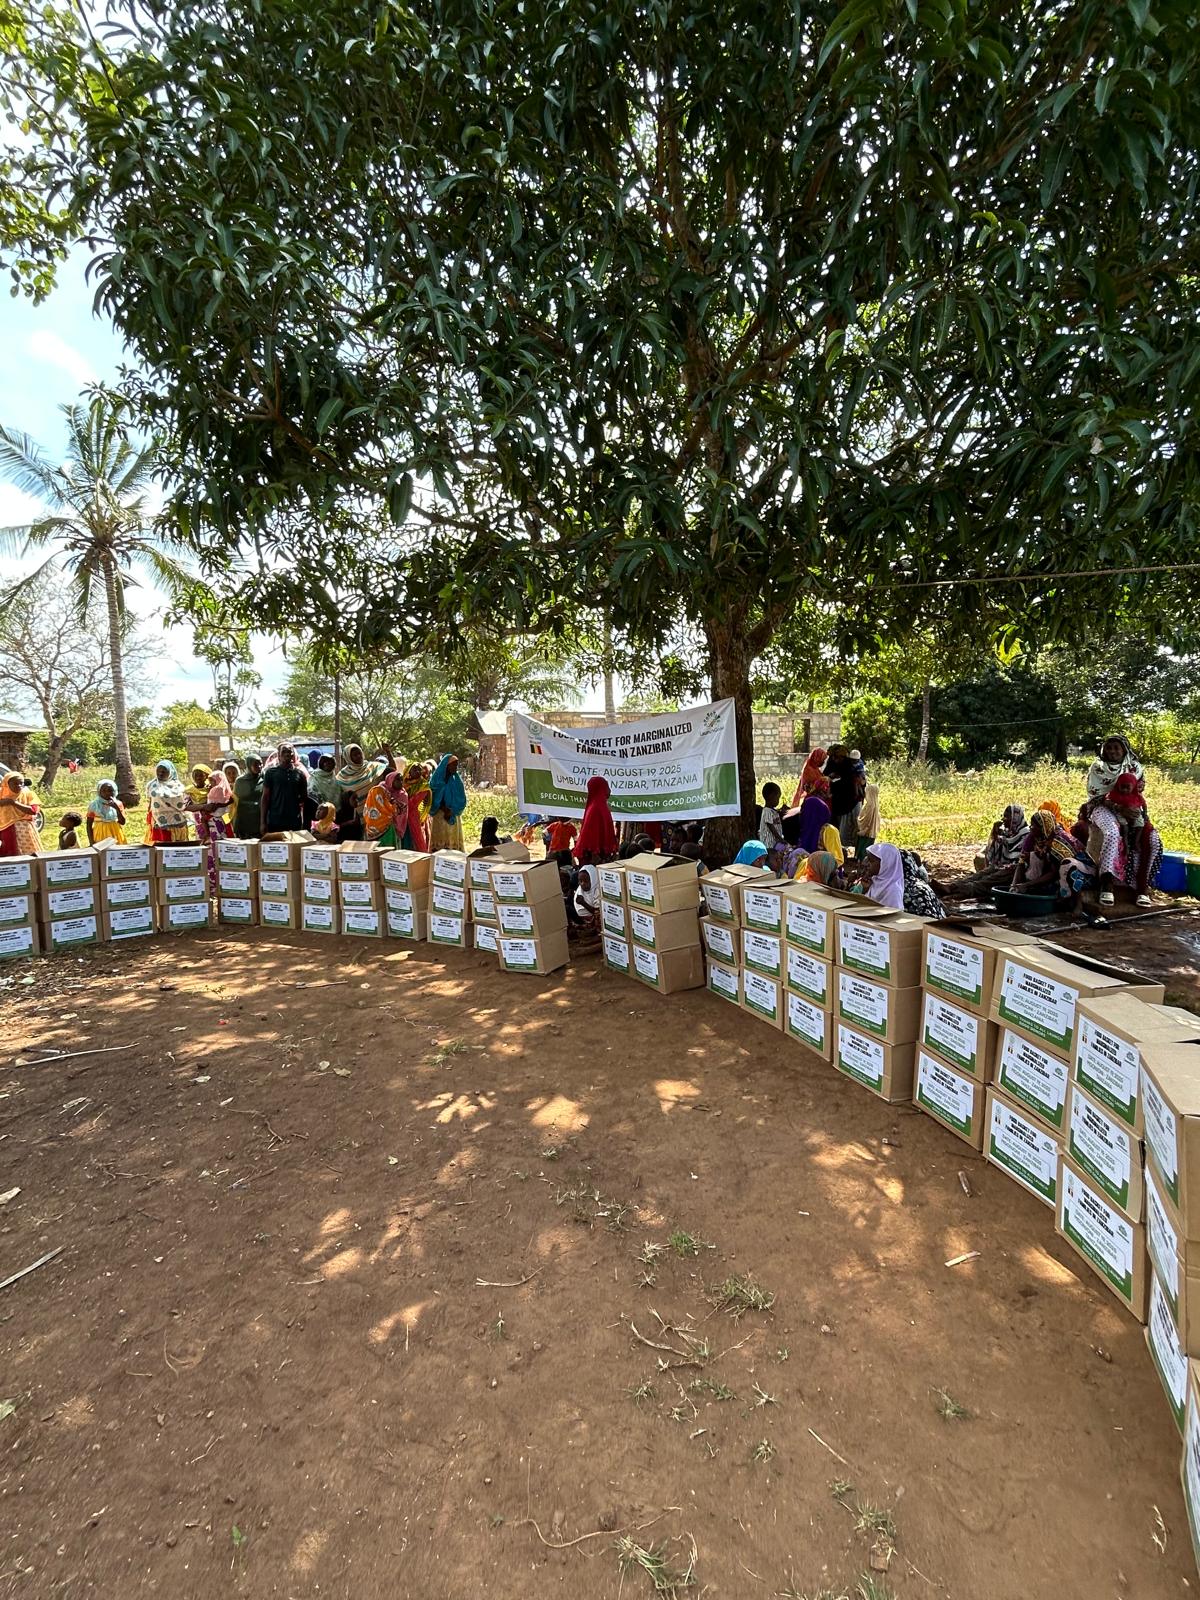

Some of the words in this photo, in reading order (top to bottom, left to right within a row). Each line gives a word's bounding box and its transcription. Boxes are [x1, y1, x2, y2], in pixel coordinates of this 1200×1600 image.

[615, 735, 631, 747] FOR
[633, 721, 693, 743] MARGINALIZED
[619, 748, 629, 759] IN
[630, 740, 673, 758] ZANZIBAR
[603, 768, 643, 778] AUGUST
[647, 767, 656, 778] 19,
[659, 764, 682, 776] 2025
[556, 775, 587, 786] UMBUJI
[651, 774, 698, 789] TANZANIA
[540, 792, 569, 802] SPECIAL
[627, 799, 660, 808] LAUNCH
[662, 797, 685, 807] GOOD
[1017, 982, 1033, 994] FAMILIES
[1038, 991, 1057, 1005] ZANZIBAR
